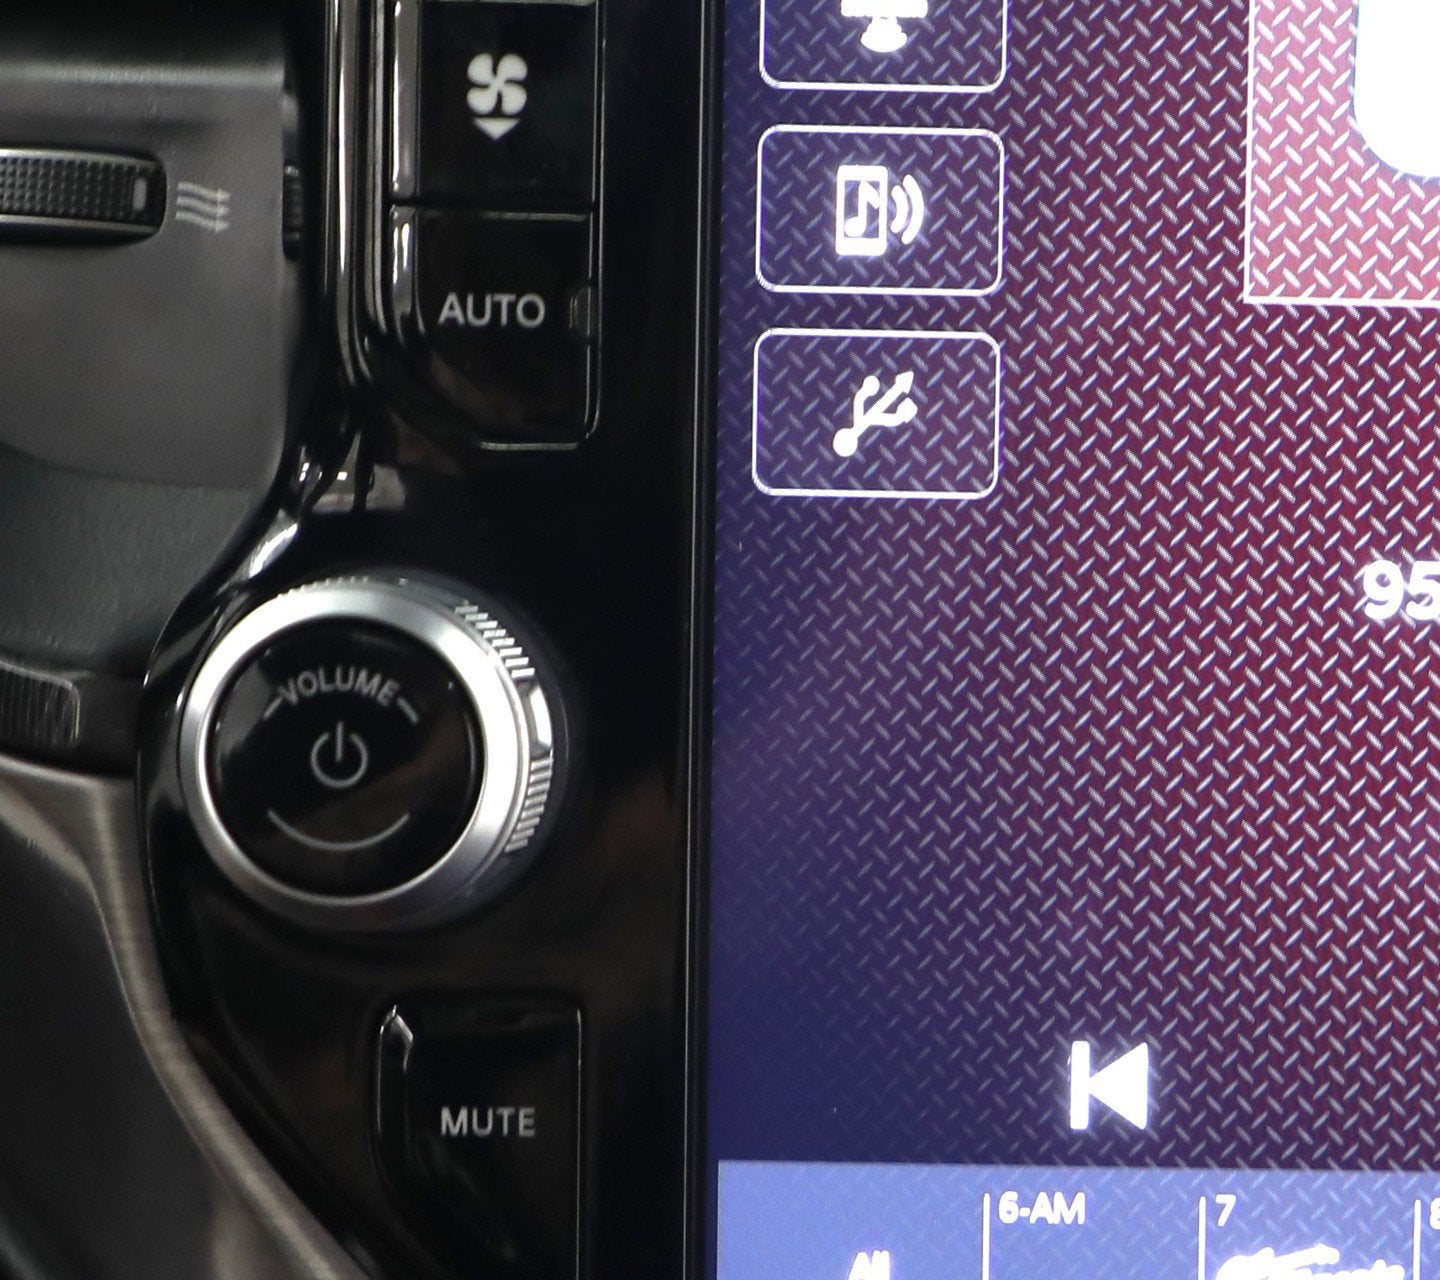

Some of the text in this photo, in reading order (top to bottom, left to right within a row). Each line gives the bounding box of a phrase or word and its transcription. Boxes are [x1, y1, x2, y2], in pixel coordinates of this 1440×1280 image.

[438, 291, 546, 329] AUTO
[278, 664, 401, 708] VOLUME
[440, 1106, 536, 1137] MUTE
[998, 1191, 1086, 1226] 6-AM
[1215, 1194, 1237, 1228] 7
